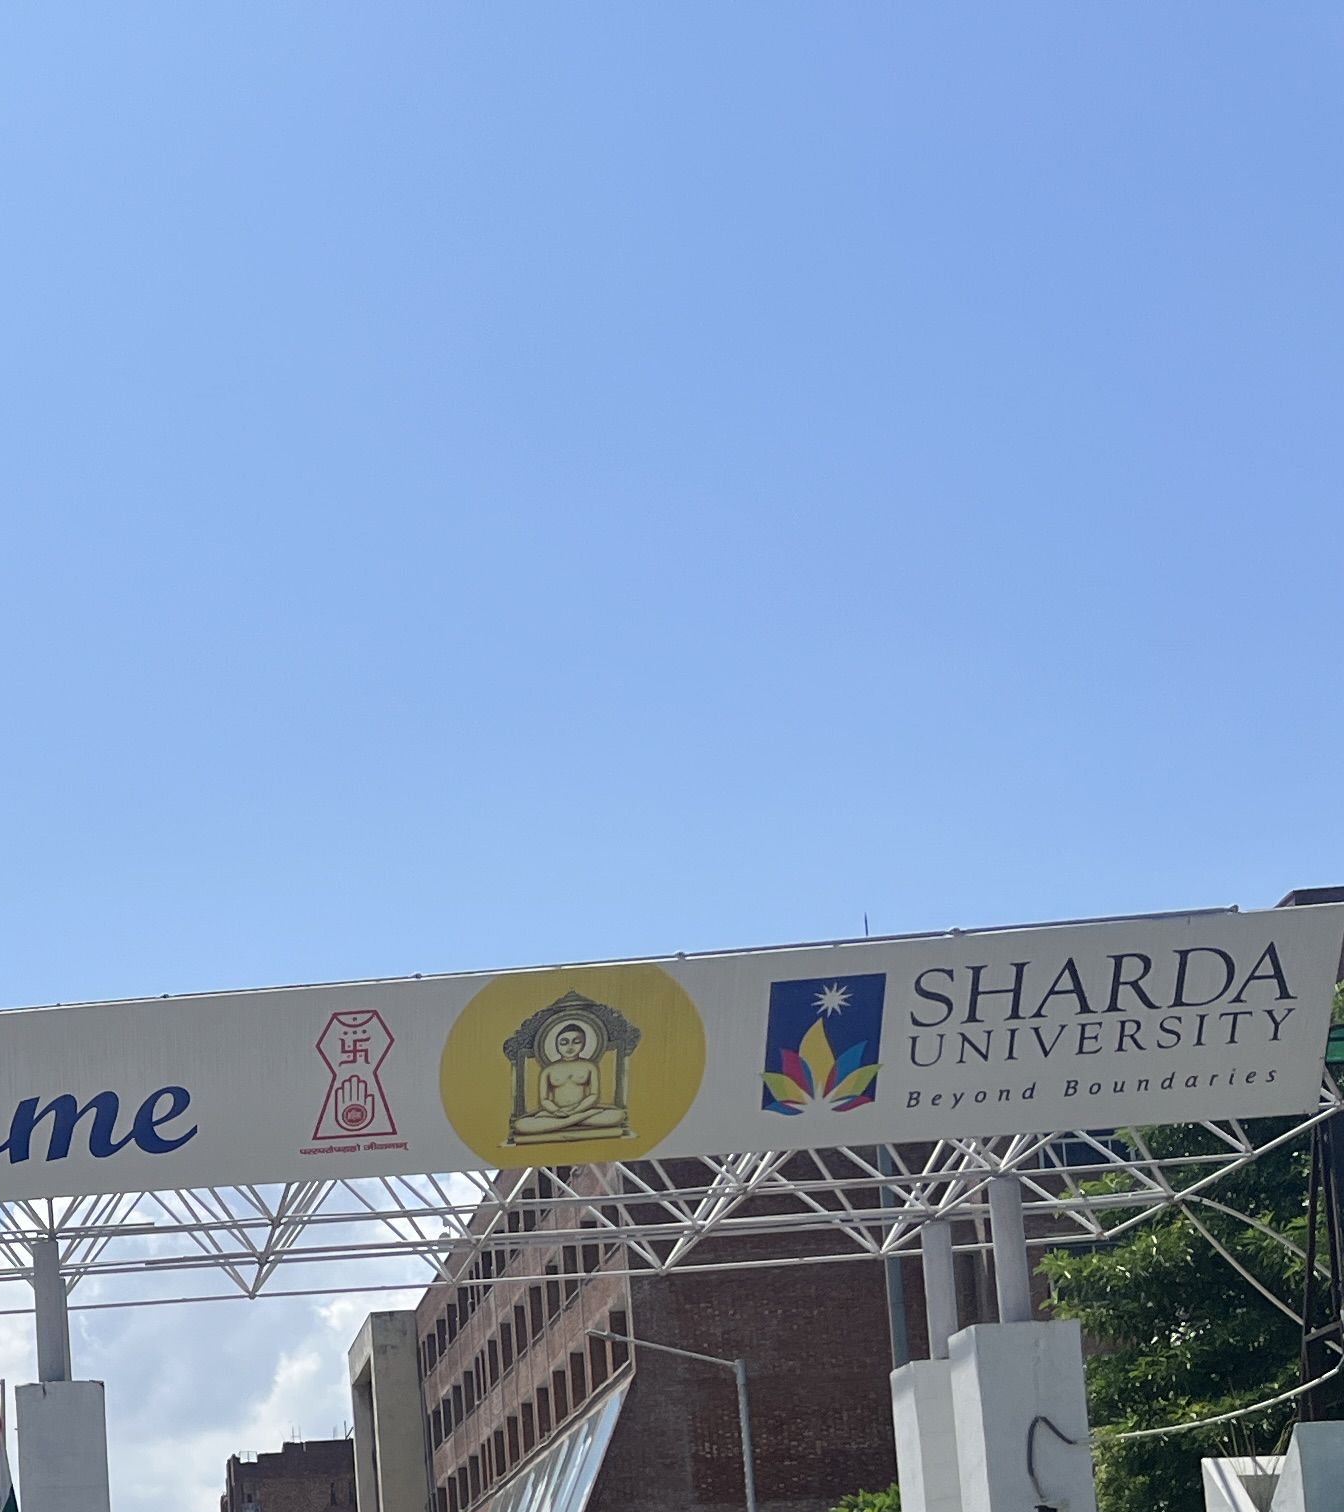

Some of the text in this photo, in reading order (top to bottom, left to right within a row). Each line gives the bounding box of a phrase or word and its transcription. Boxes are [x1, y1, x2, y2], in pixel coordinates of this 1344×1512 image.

[910, 941, 1298, 1028] SHARDA
[908, 1008, 1296, 1068] UNIVERSITY
[905, 1067, 1278, 1110] Beyond Boundaries
